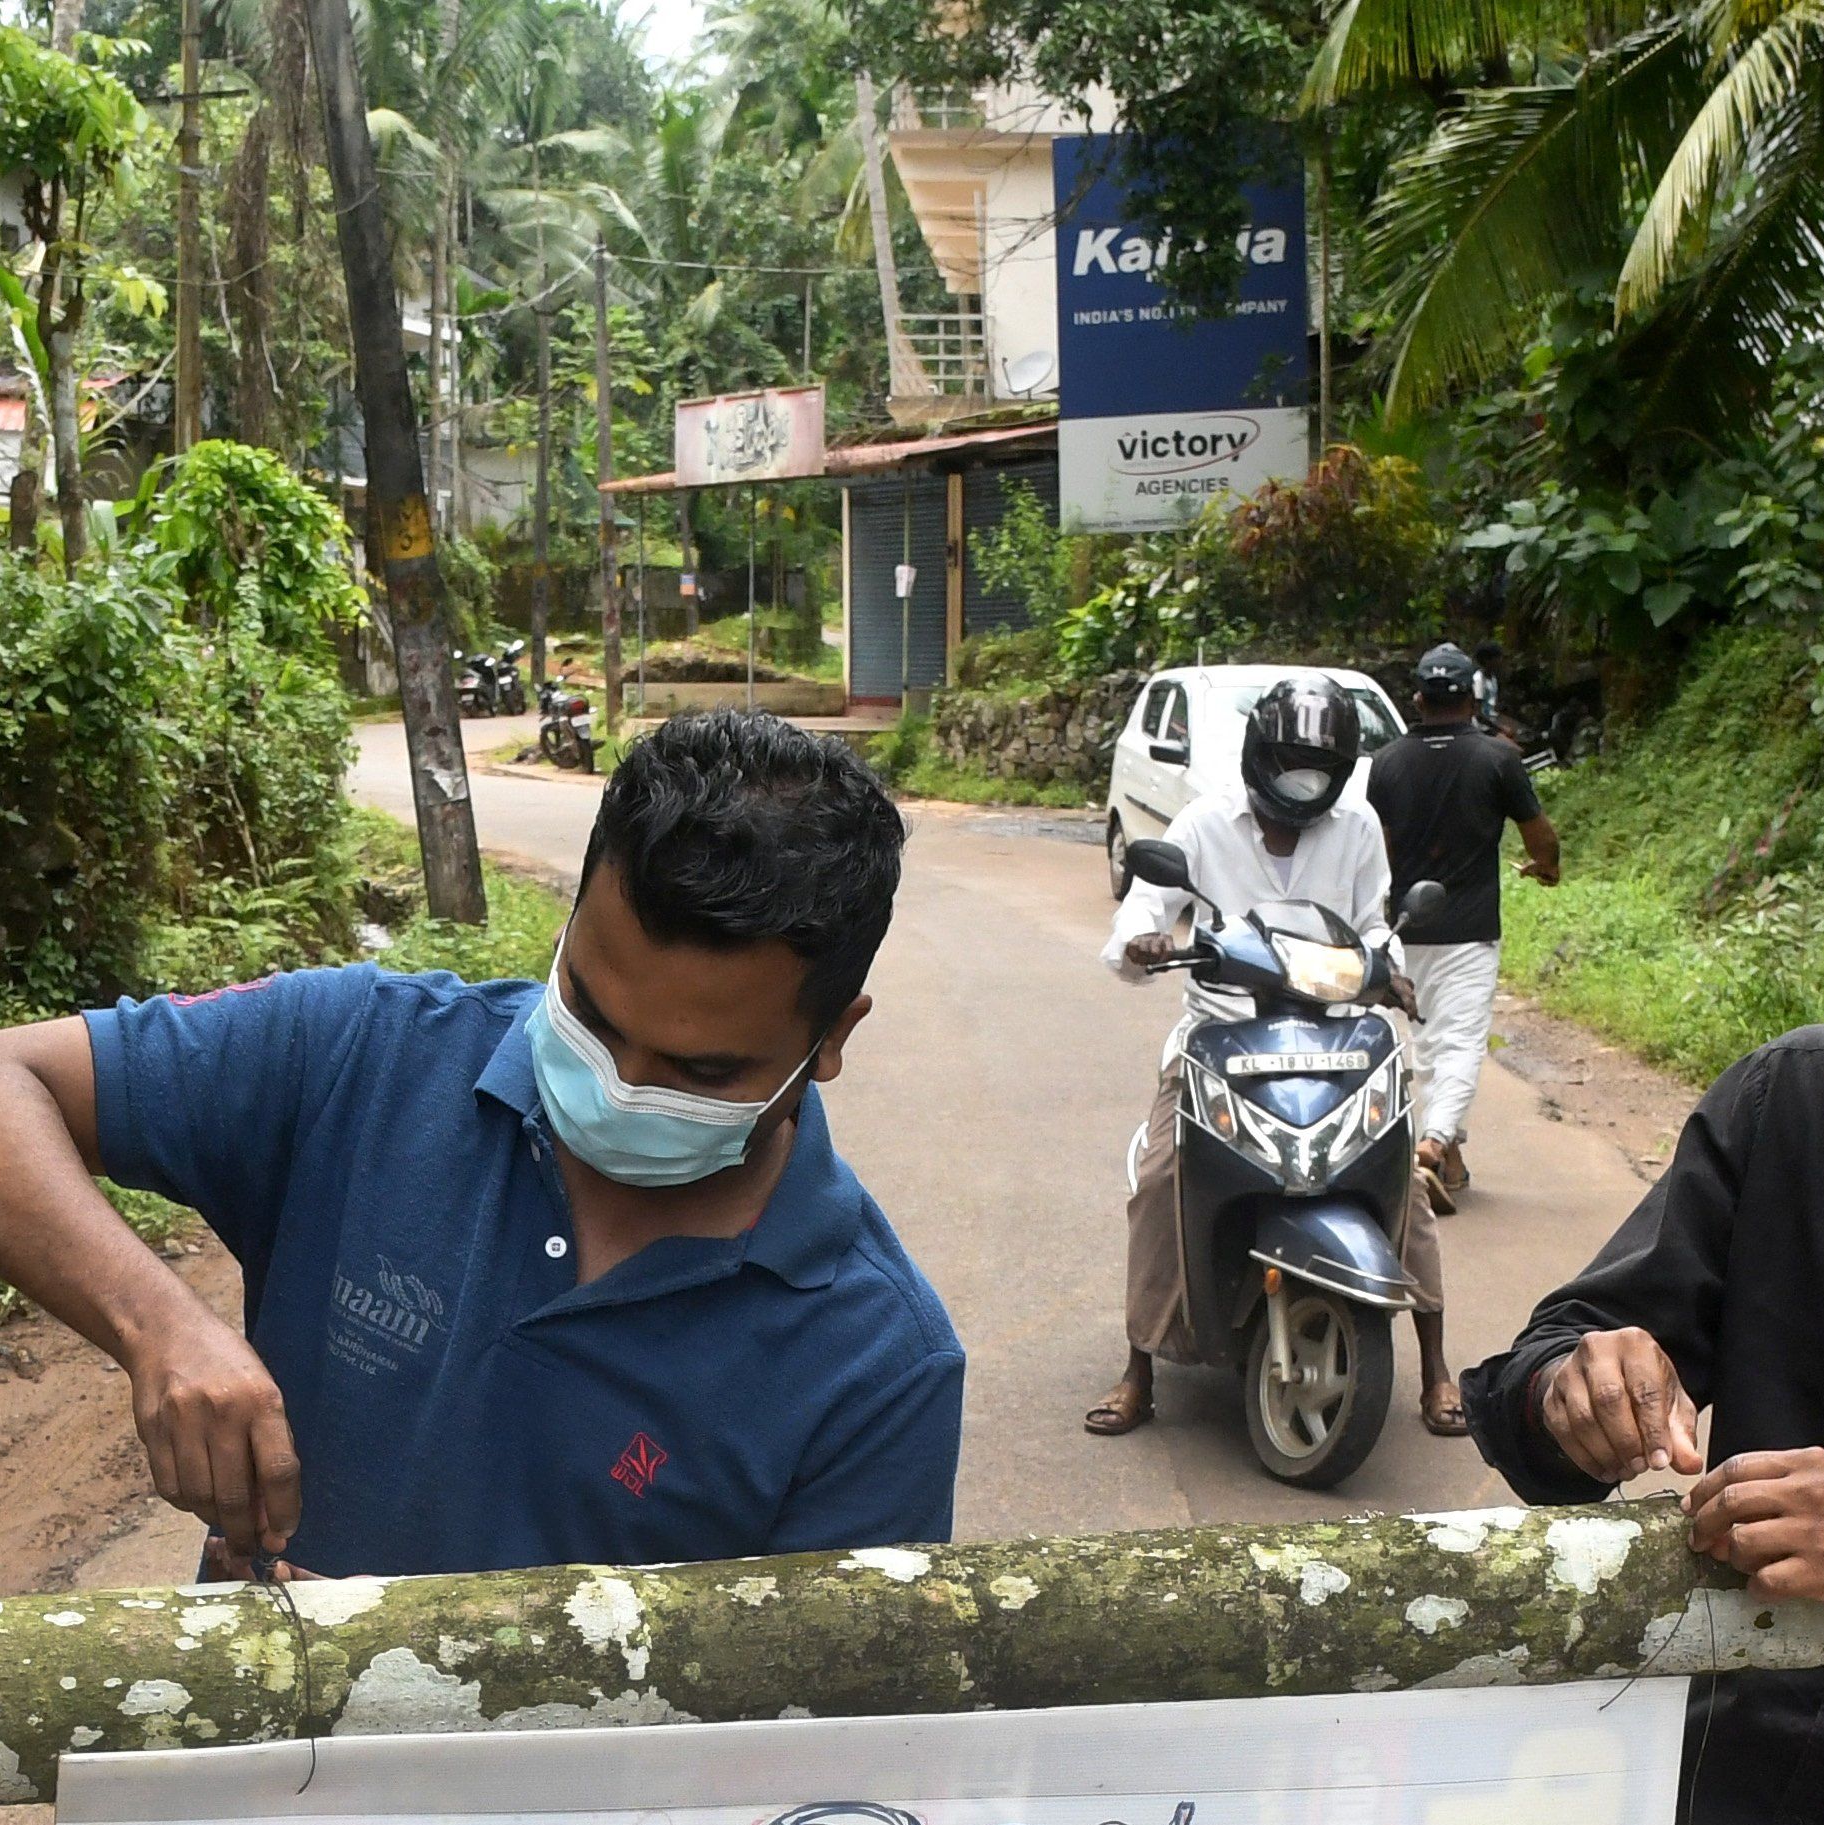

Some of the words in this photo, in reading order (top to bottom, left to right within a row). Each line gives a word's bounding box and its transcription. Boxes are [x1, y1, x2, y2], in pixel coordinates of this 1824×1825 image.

[1074, 307, 1135, 325] INDIA'S
[1117, 429, 1248, 462] victory
[1135, 477, 1229, 496] AGENCIES
